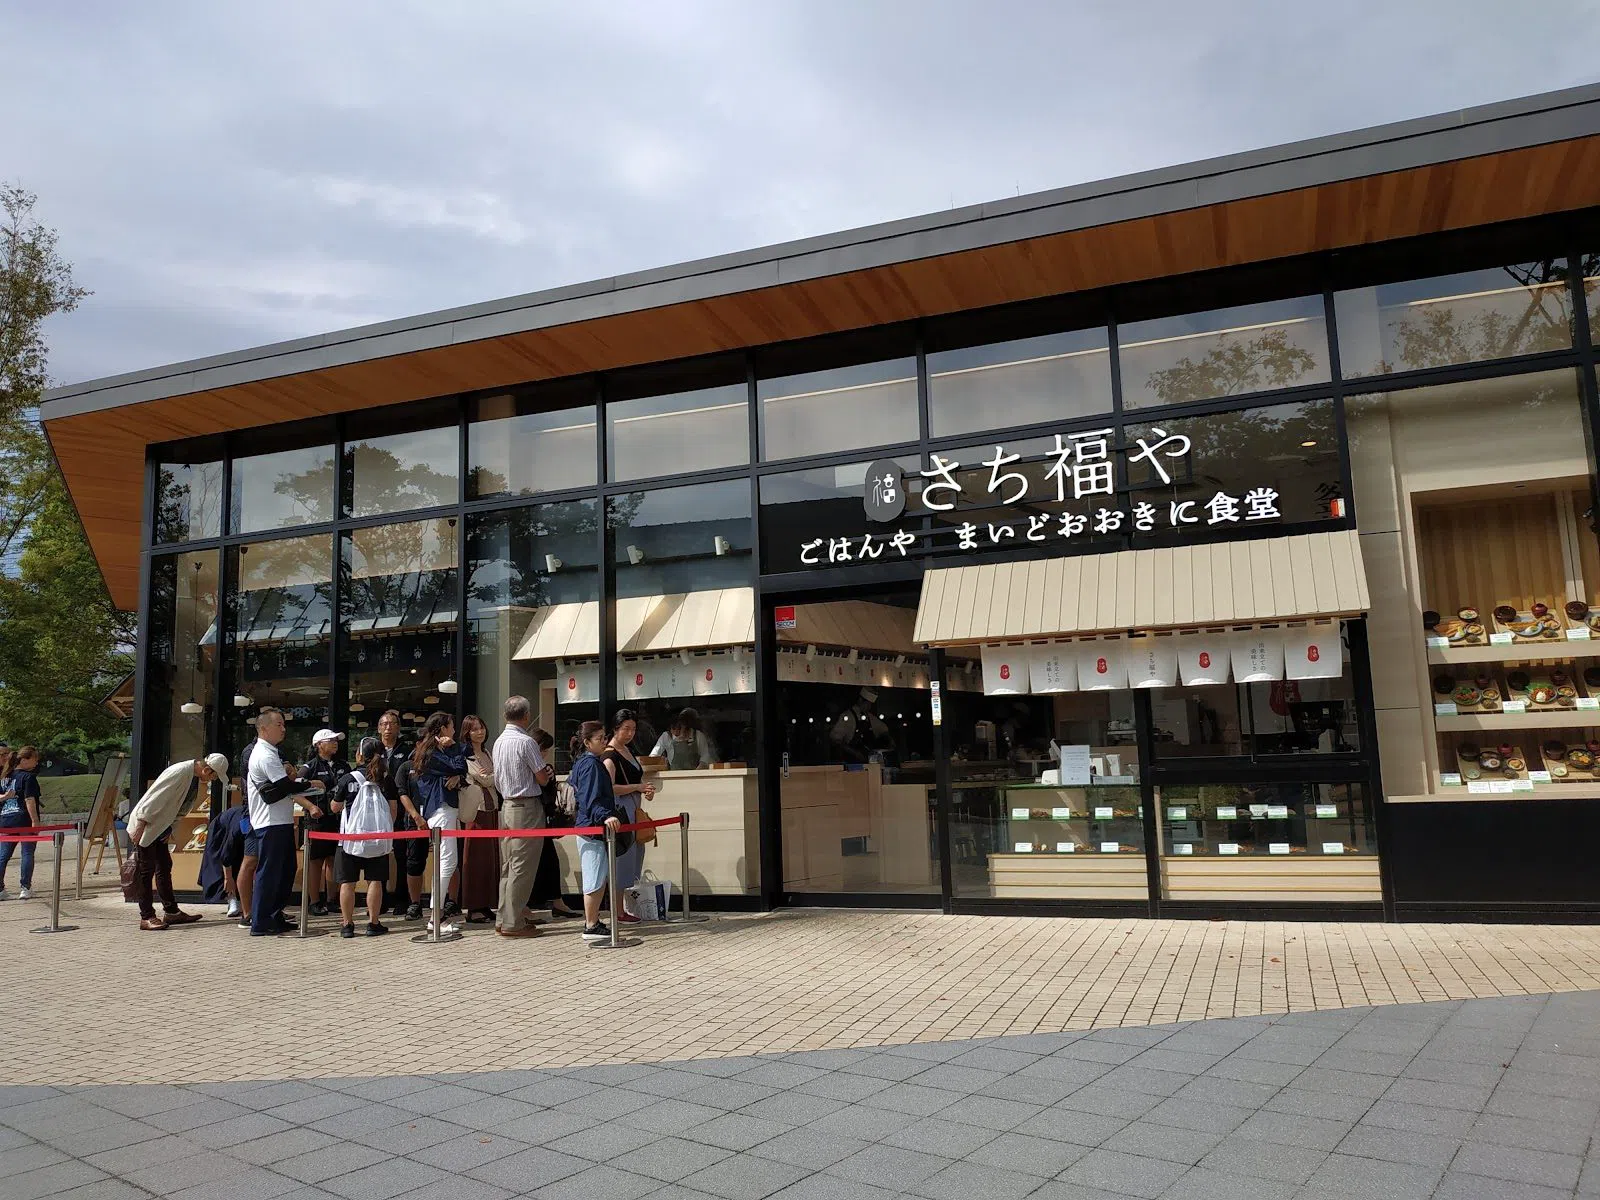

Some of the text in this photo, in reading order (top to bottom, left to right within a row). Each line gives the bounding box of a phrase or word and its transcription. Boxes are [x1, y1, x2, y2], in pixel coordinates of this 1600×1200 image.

[920, 427, 1192, 511] さち福や
[799, 486, 1282, 565] ごはんや まいどおおきに食堂
